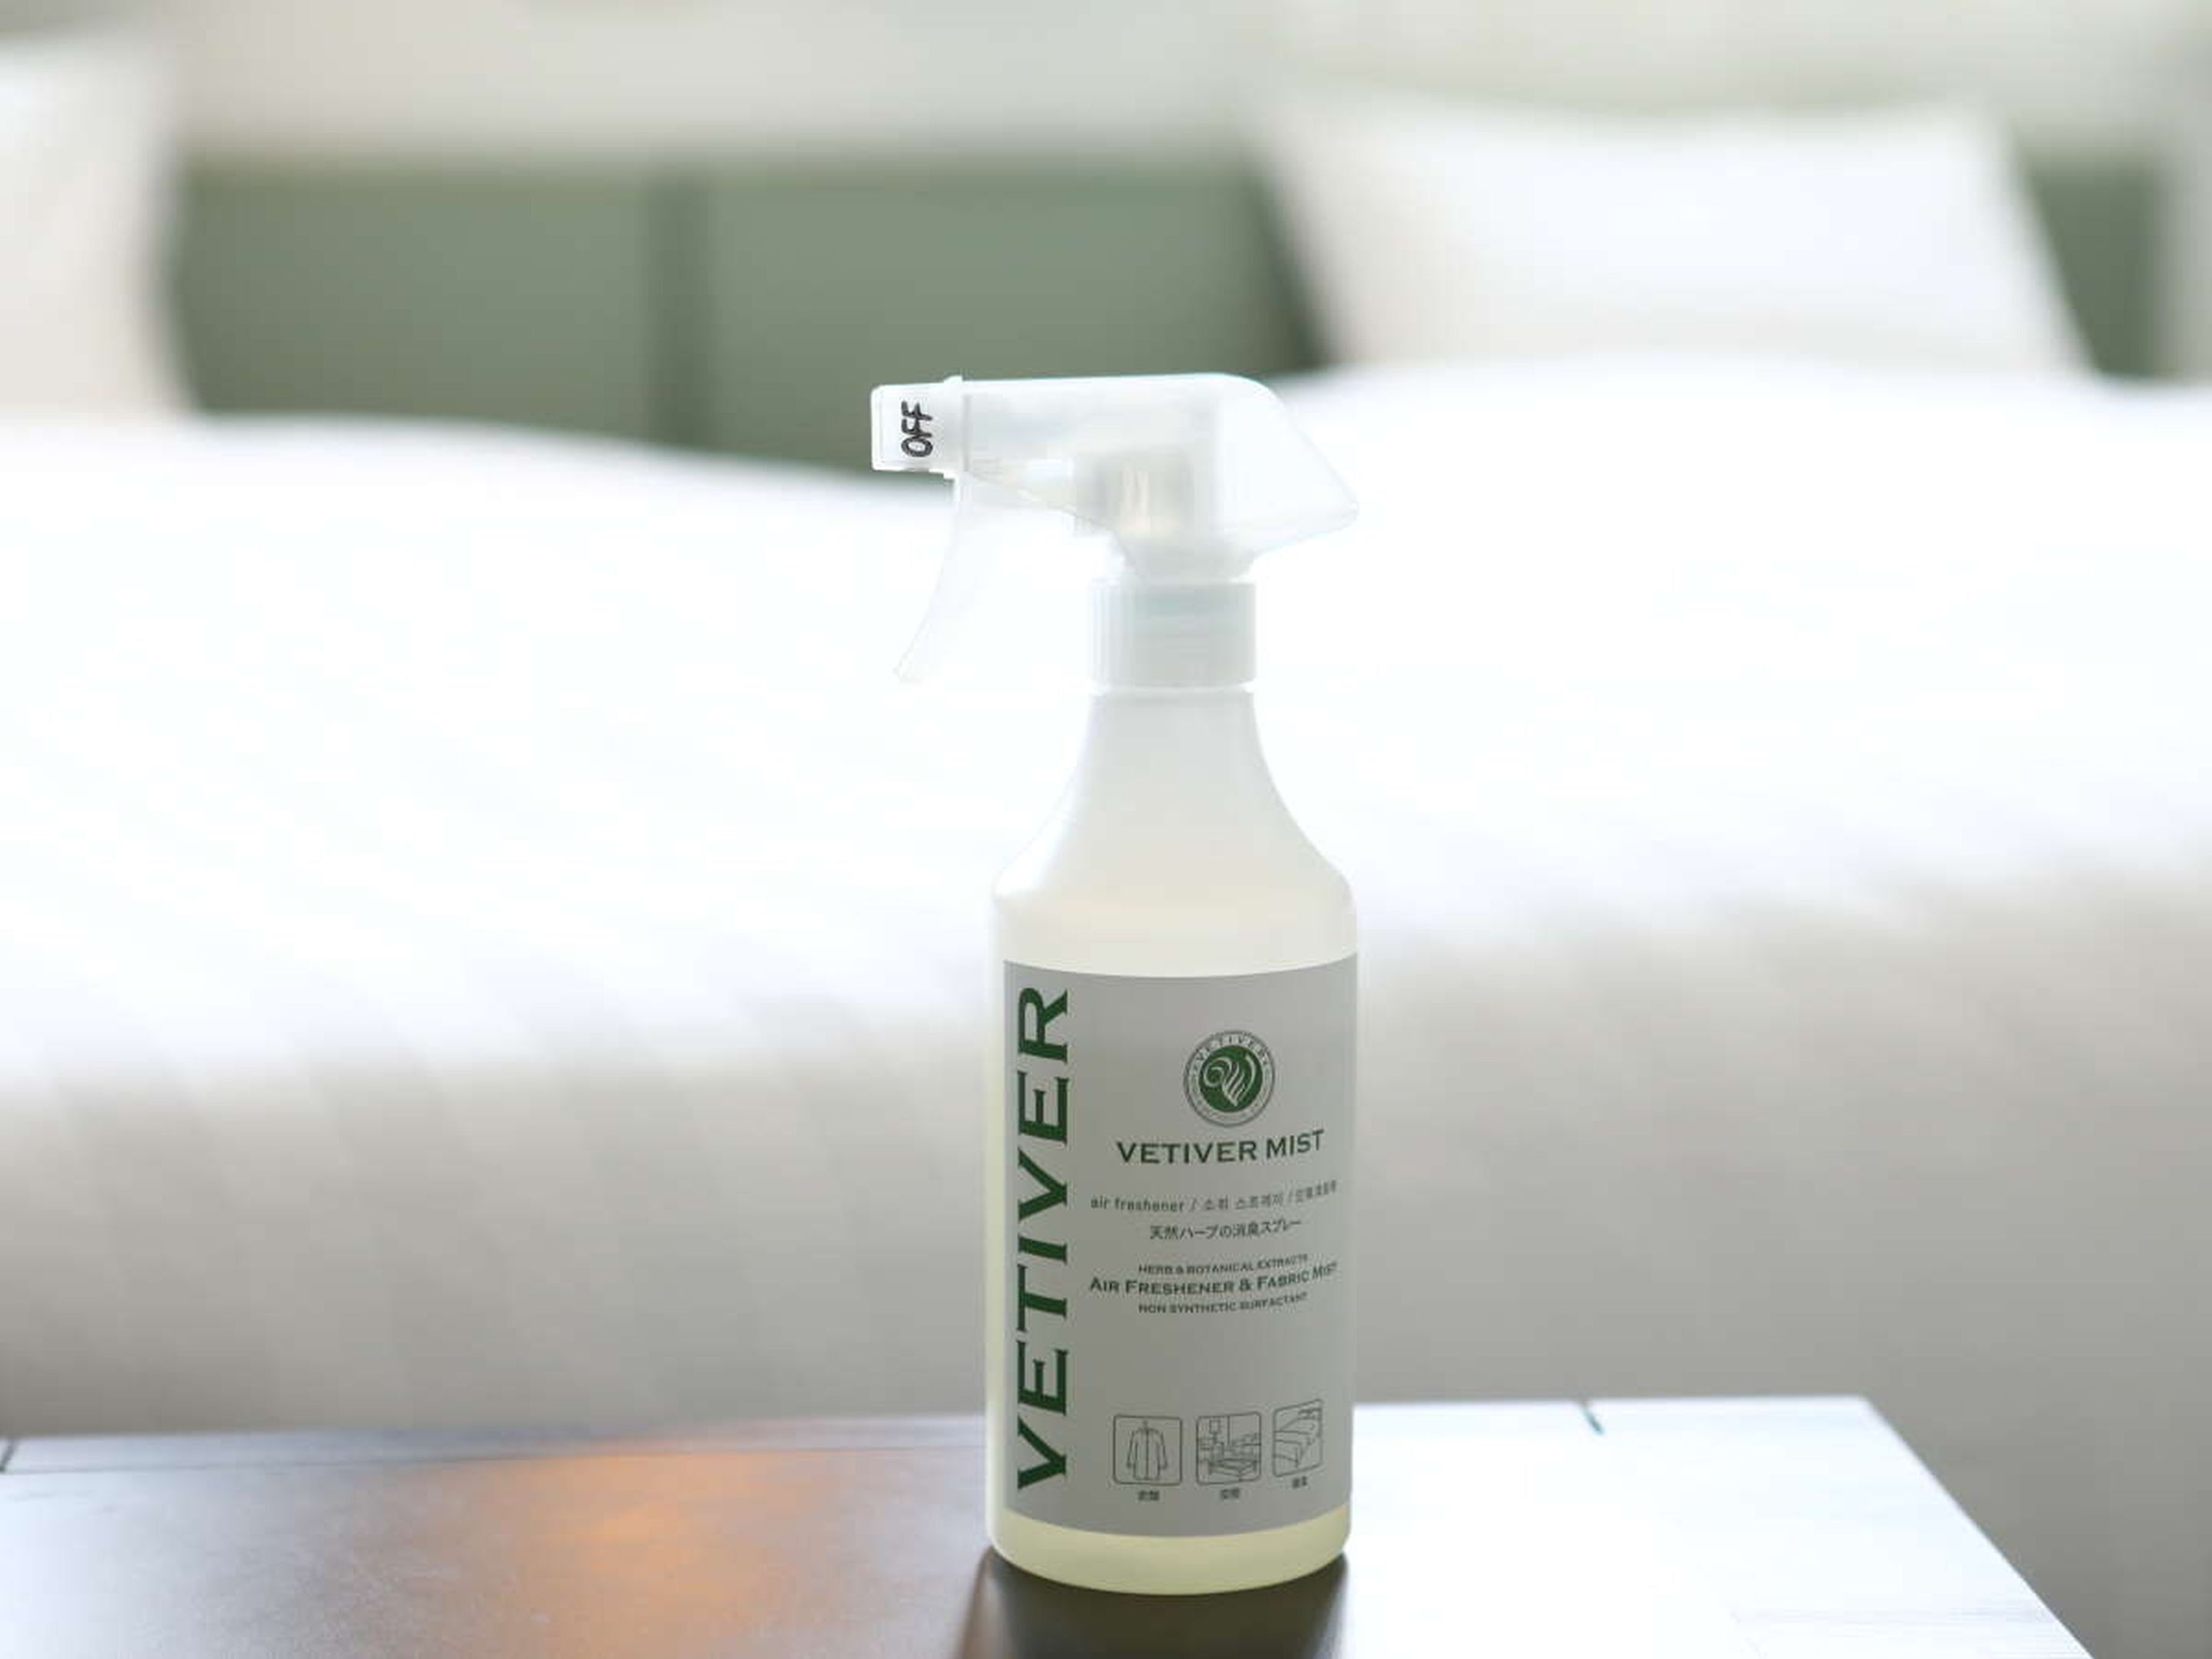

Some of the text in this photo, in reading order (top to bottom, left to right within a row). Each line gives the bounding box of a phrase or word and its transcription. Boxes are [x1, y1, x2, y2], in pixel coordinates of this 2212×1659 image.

[901, 401, 933, 457] OFF
[1117, 1129, 1324, 1164] VETIVER MIST
[1091, 1196, 1111, 1209] air
[1114, 1197, 1184, 1211] freshener
[1018, 987, 1068, 1489] VETIVER
[1138, 1264, 1173, 1275] HERB
[1187, 1263, 1254, 1275] BOTANICAL
[1239, 1278, 1252, 1292] &
[1138, 1303, 1167, 1313] NON
